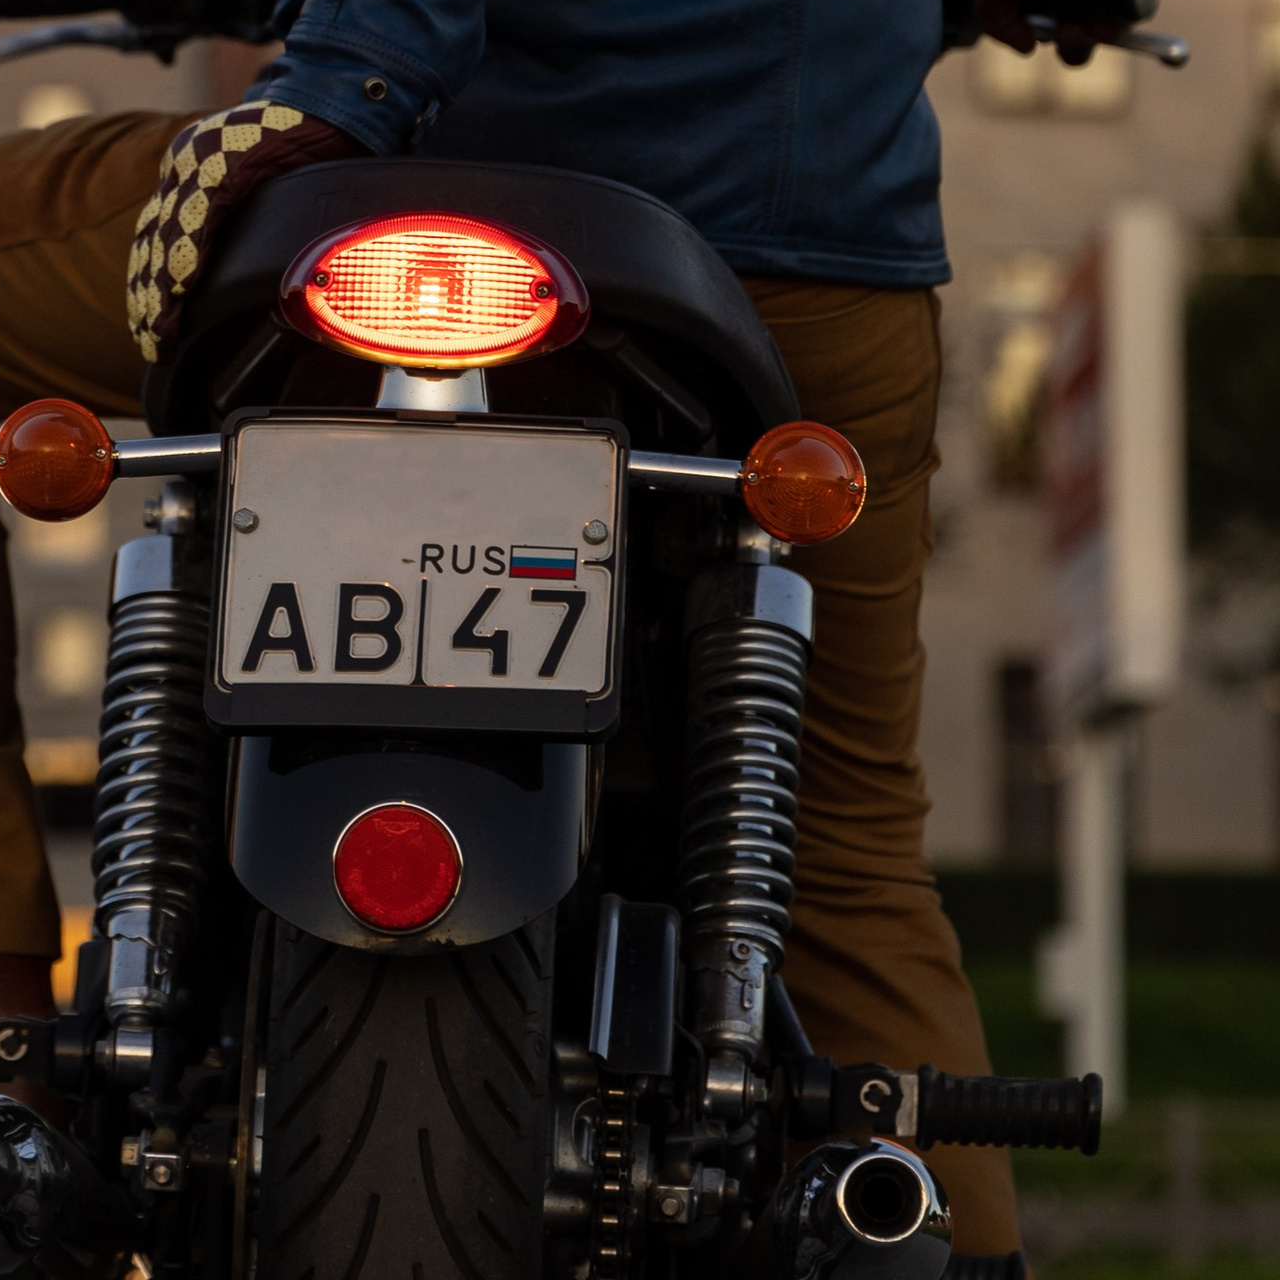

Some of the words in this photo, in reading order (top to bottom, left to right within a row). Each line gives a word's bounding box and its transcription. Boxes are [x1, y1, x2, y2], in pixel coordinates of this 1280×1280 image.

[420, 543, 506, 575] RUS
[240, 581, 405, 673] AB
[451, 585, 588, 679] 47
